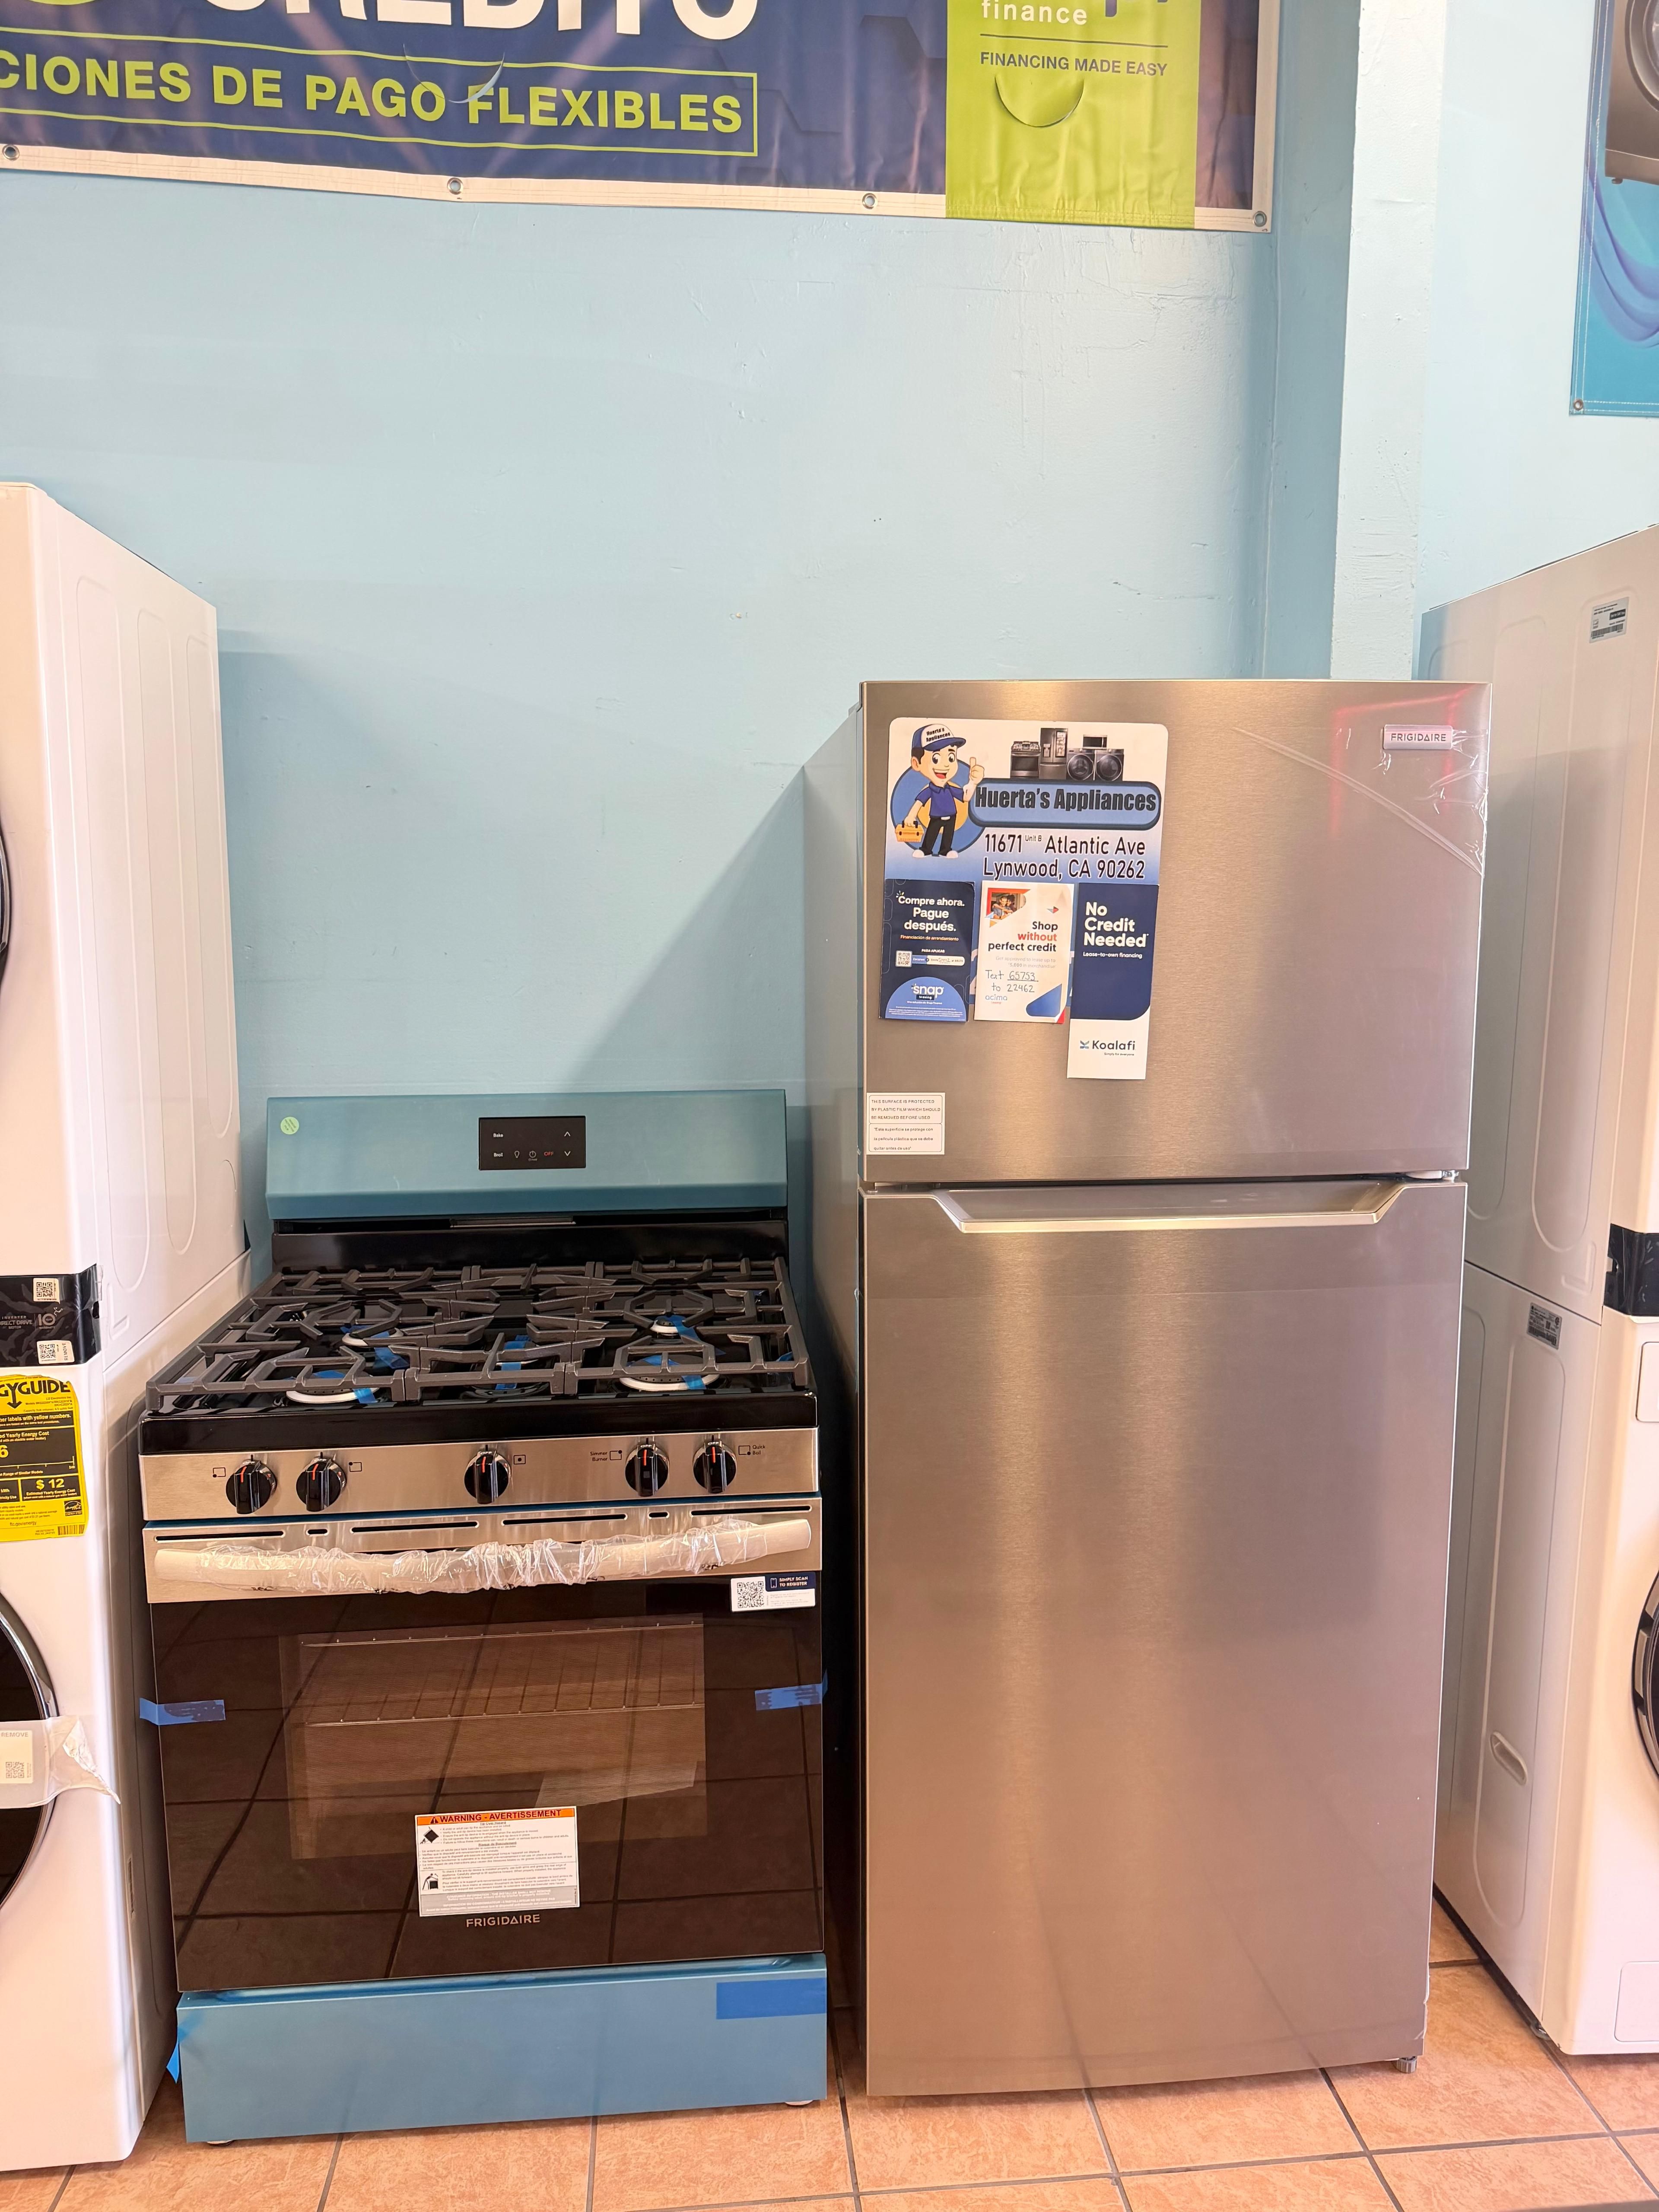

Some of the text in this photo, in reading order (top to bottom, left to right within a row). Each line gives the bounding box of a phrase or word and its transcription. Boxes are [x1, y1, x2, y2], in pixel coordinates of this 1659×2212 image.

[981, 0, 1087, 25] finance
[980, 52, 1168, 76] FINANCING MADE EASY
[213, 65, 283, 108] DE
[306, 74, 446, 121] PAGO
[468, 84, 742, 133] FLEXIBLES
[1391, 733, 1446, 741] FRIGIDAIRE
[975, 787, 1156, 811] Huerta's Appliances
[985, 834, 1022, 853] 11671
[1045, 835, 1109, 855] Atlantic
[1115, 837, 1145, 855] Ave
[984, 857, 1144, 880] Lynwood, CA 90262
[898, 895, 965, 906] Compre ahora.
[913, 907, 949, 918] Pague
[1085, 901, 1107, 916] No
[904, 920, 956, 932] después.
[1032, 921, 1058, 932] Shop
[1084, 917, 1135, 932] Credit
[1018, 932, 1057, 941] without
[988, 942, 1056, 952] perfect credit
[985, 970, 1004, 980] Text
[913, 985, 944, 998] snap
[992, 982, 1035, 993] to 22462
[1092, 1040, 1135, 1050] Koalafi
[38, 1313, 56, 1326] 10
[36, 1478, 64, 1490] $ 12
[440, 1814, 482, 1823] WARNING
[489, 1809, 561, 1820] AVERTISSEMENT
[466, 1914, 540, 1927] FRIGIDAIRE
